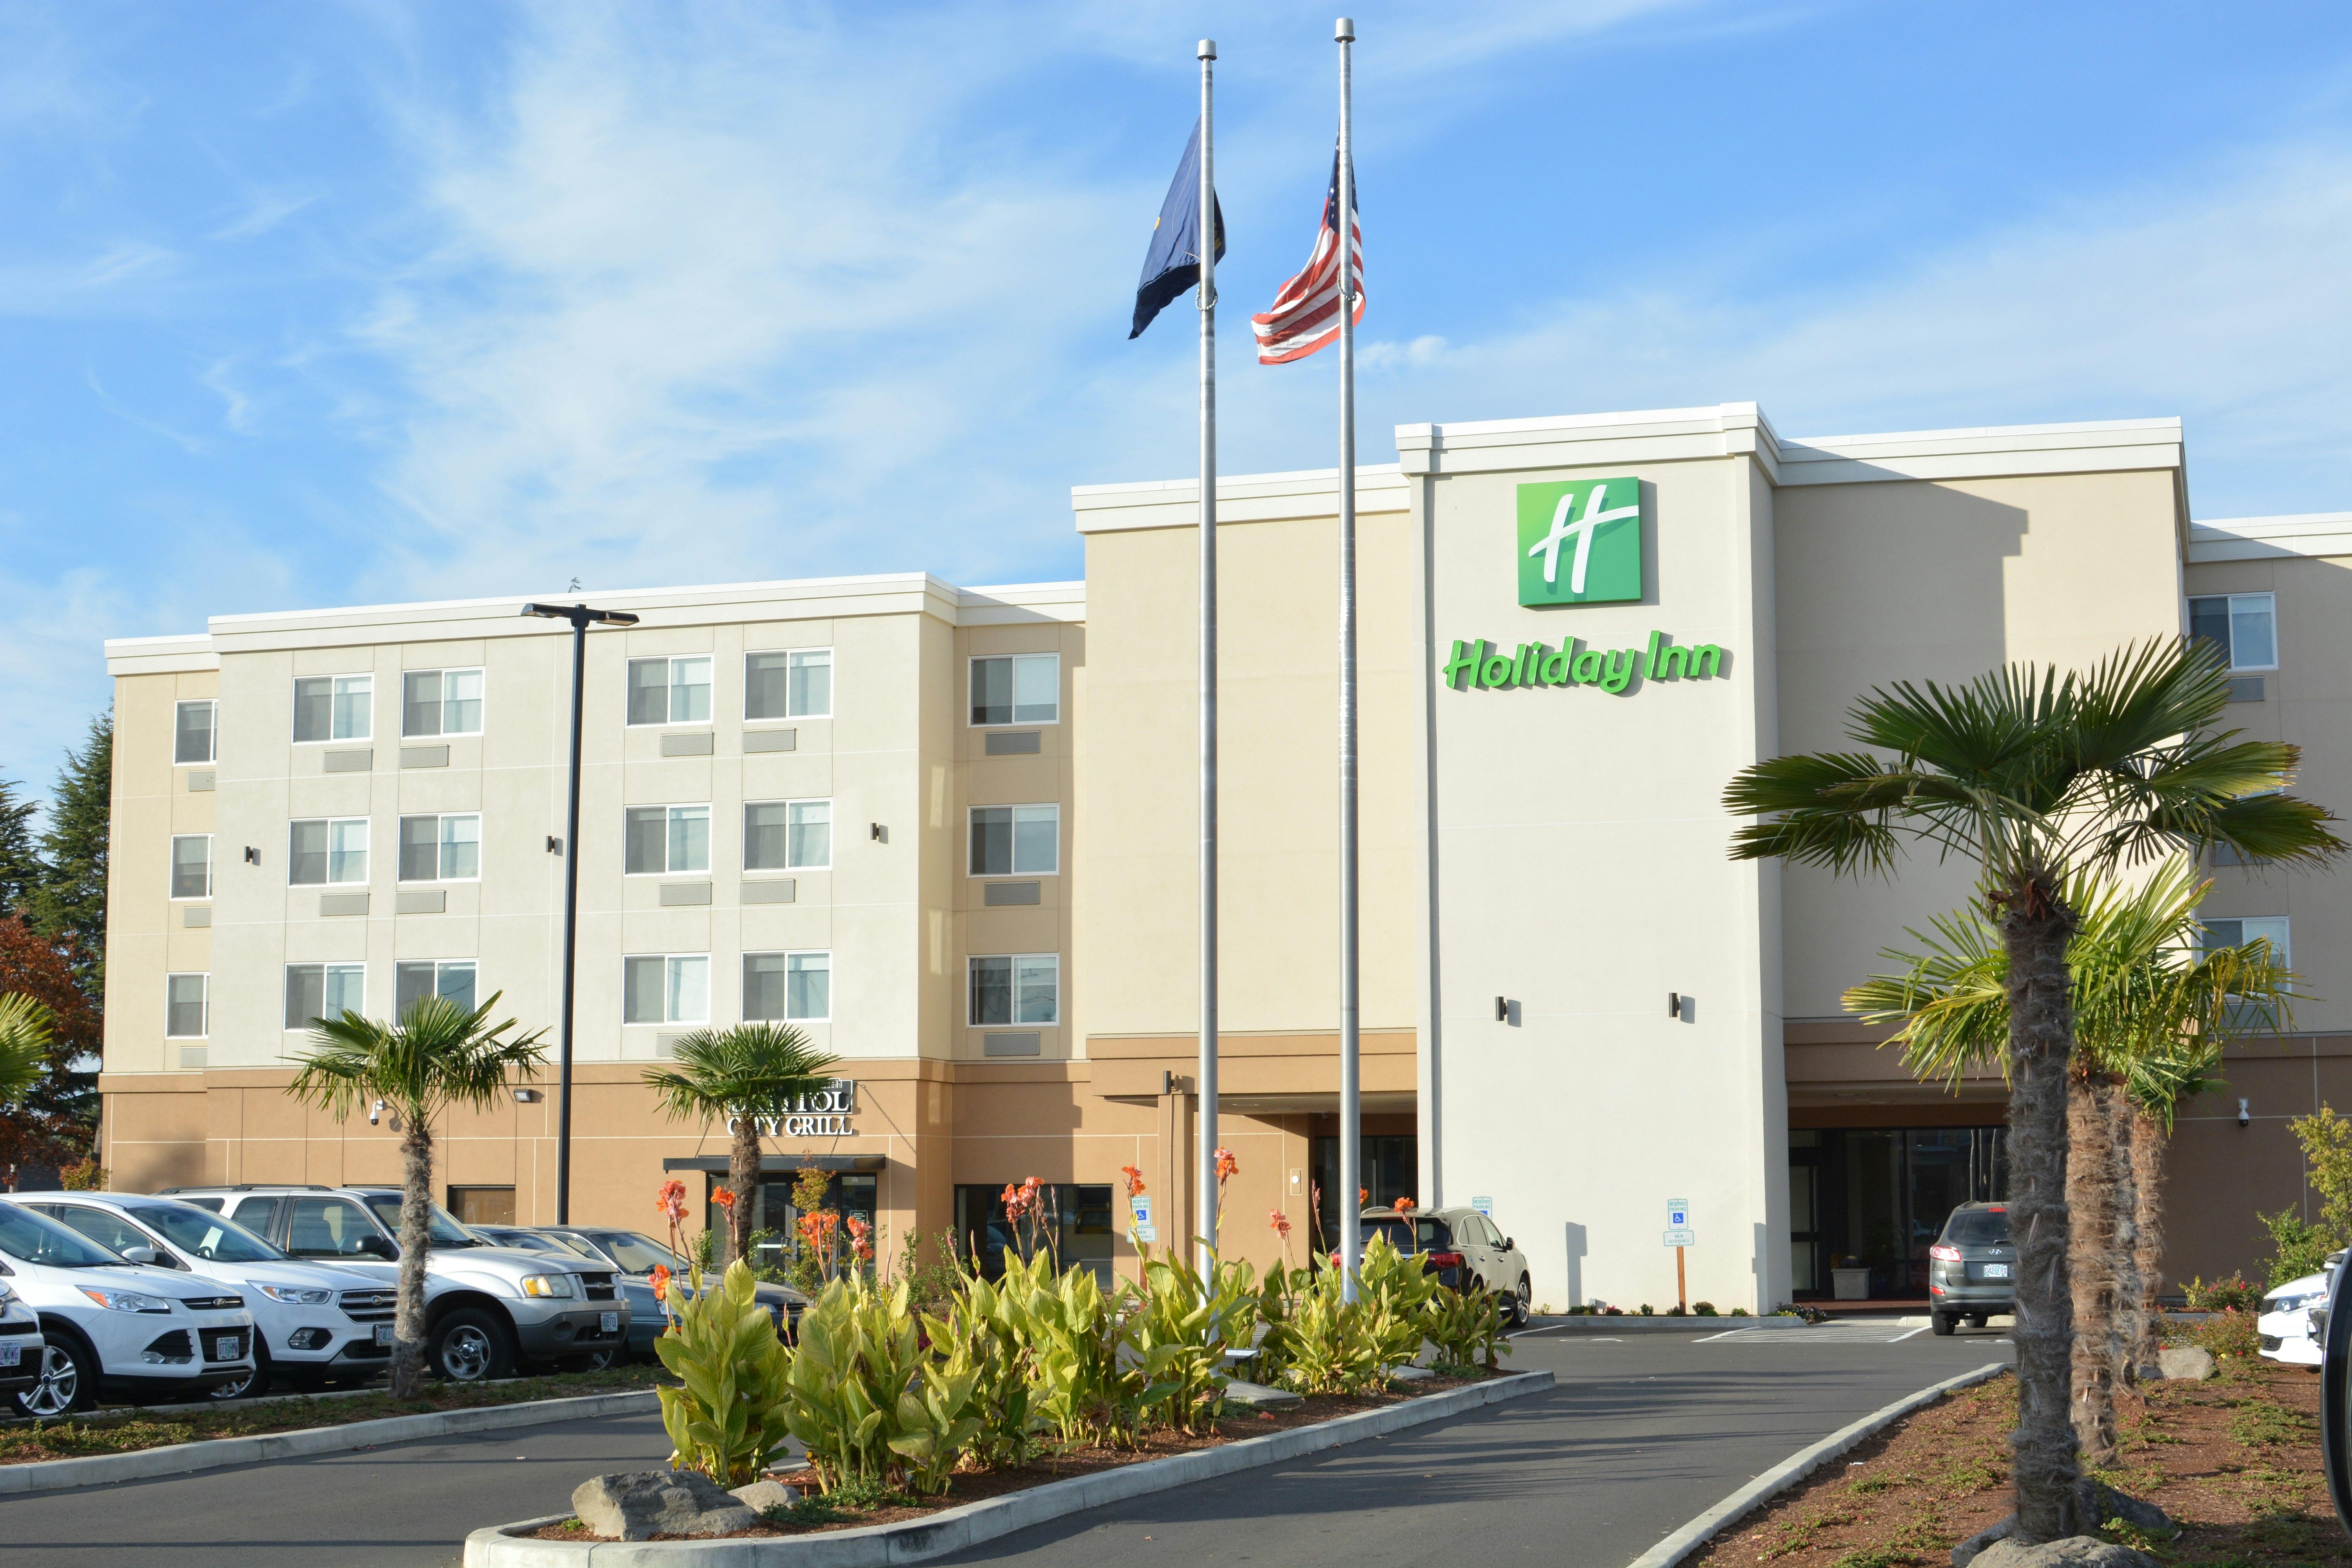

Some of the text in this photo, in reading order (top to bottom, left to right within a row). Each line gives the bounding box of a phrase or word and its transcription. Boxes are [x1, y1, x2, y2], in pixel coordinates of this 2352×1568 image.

[1443, 630, 1721, 694] Holiday Inn
[727, 1116, 853, 1136] CTY GRILL
